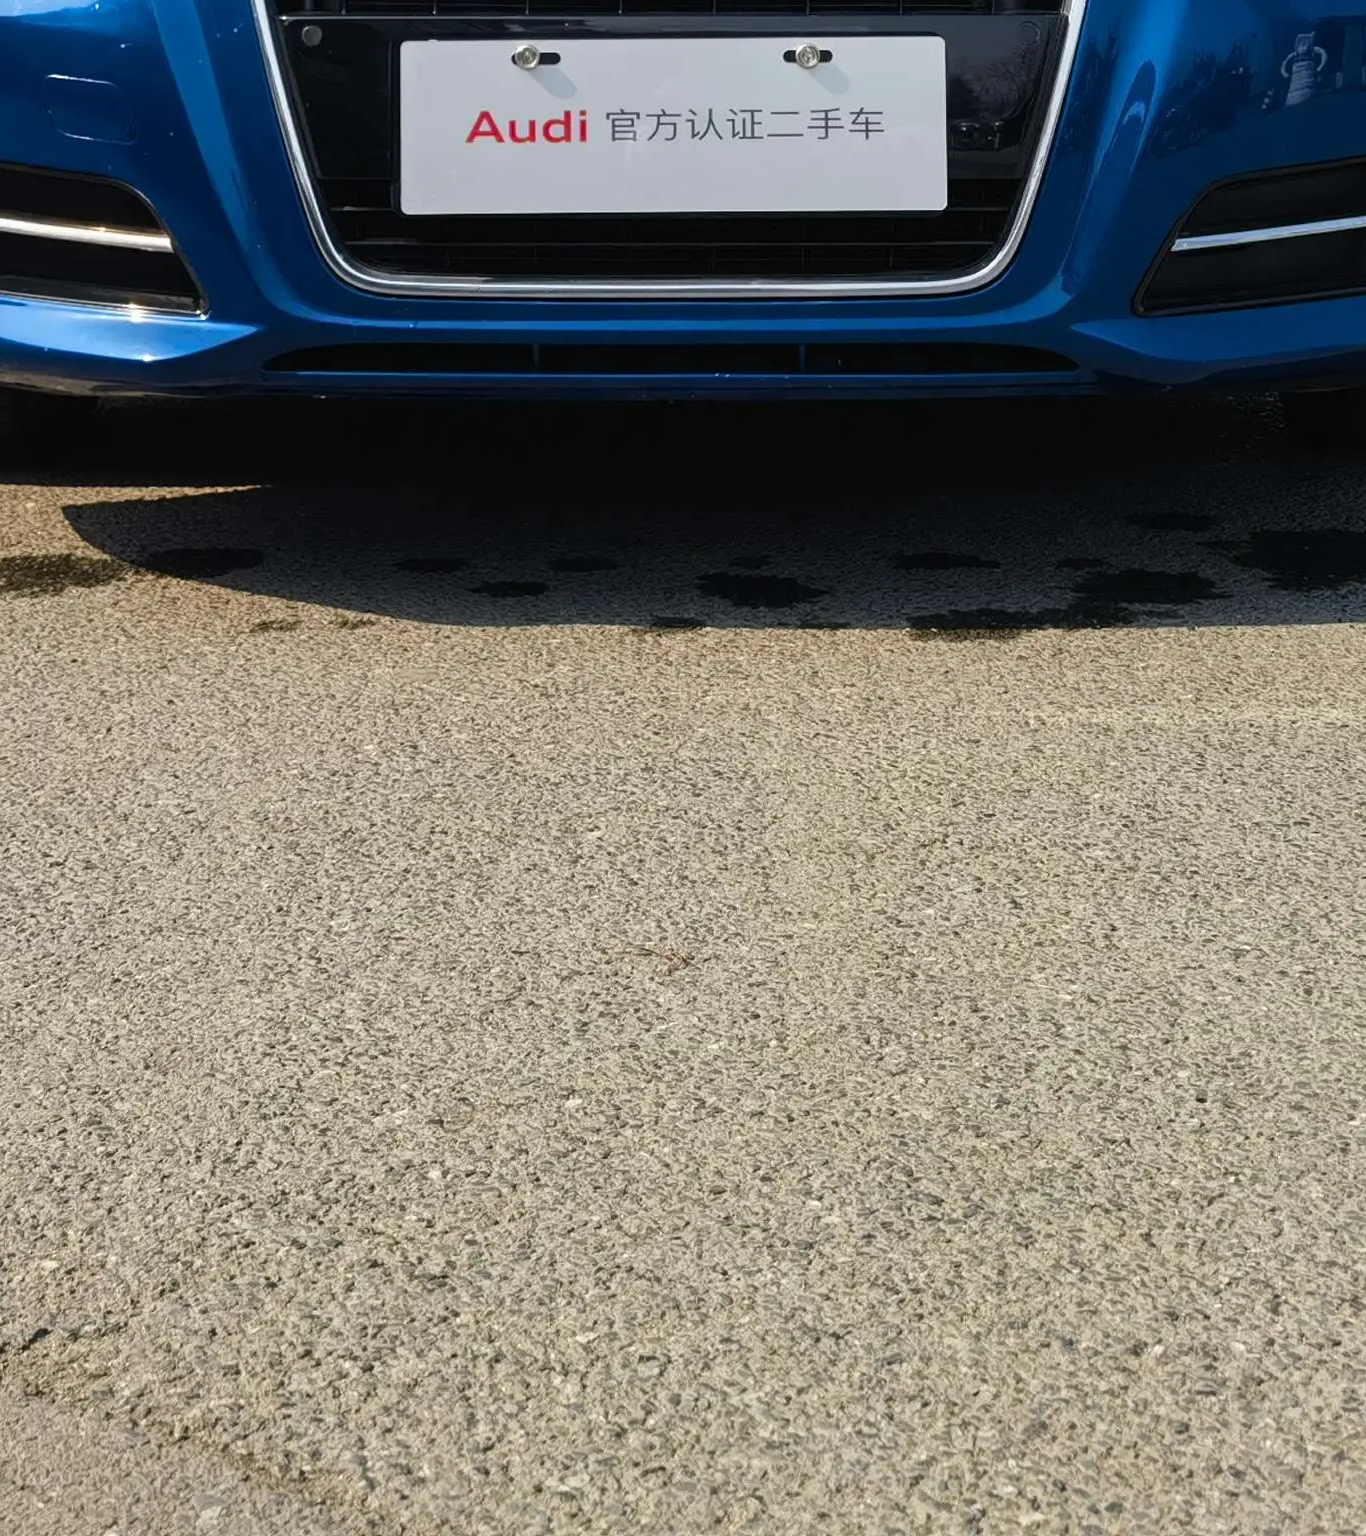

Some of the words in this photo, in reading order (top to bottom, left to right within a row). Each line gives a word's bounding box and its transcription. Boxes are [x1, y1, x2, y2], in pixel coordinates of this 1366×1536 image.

[465, 110, 587, 144] Audi
[605, 108, 885, 142] 官方认证二手车
